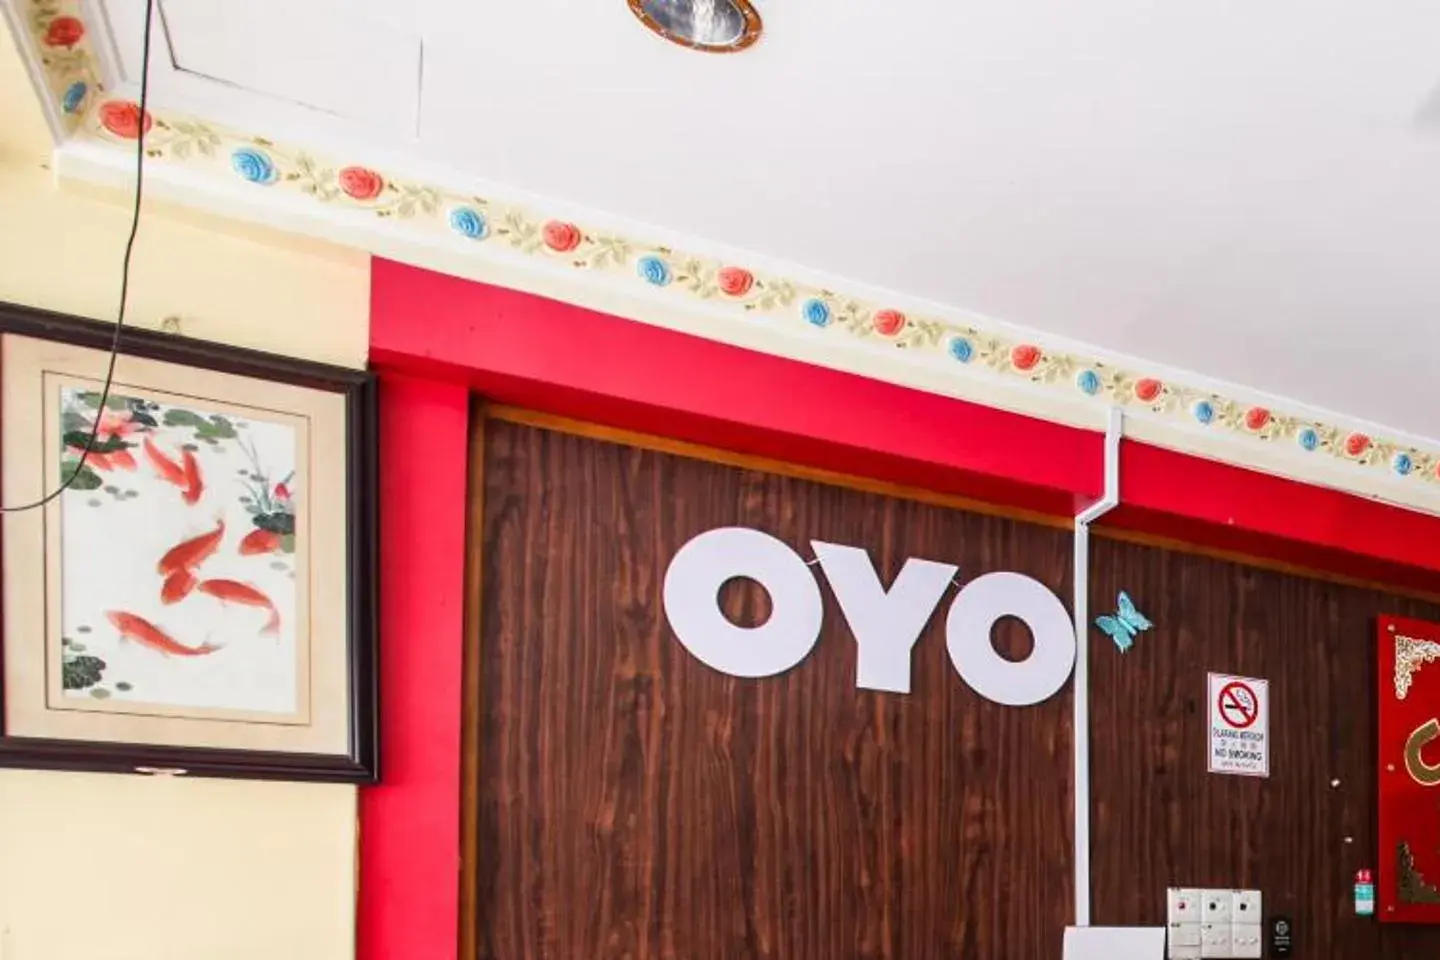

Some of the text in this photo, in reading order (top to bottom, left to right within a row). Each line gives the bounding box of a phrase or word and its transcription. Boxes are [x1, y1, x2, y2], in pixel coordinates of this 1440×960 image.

[663, 526, 1077, 706] OYO
[1215, 748, 1263, 761] NO SMOKING
